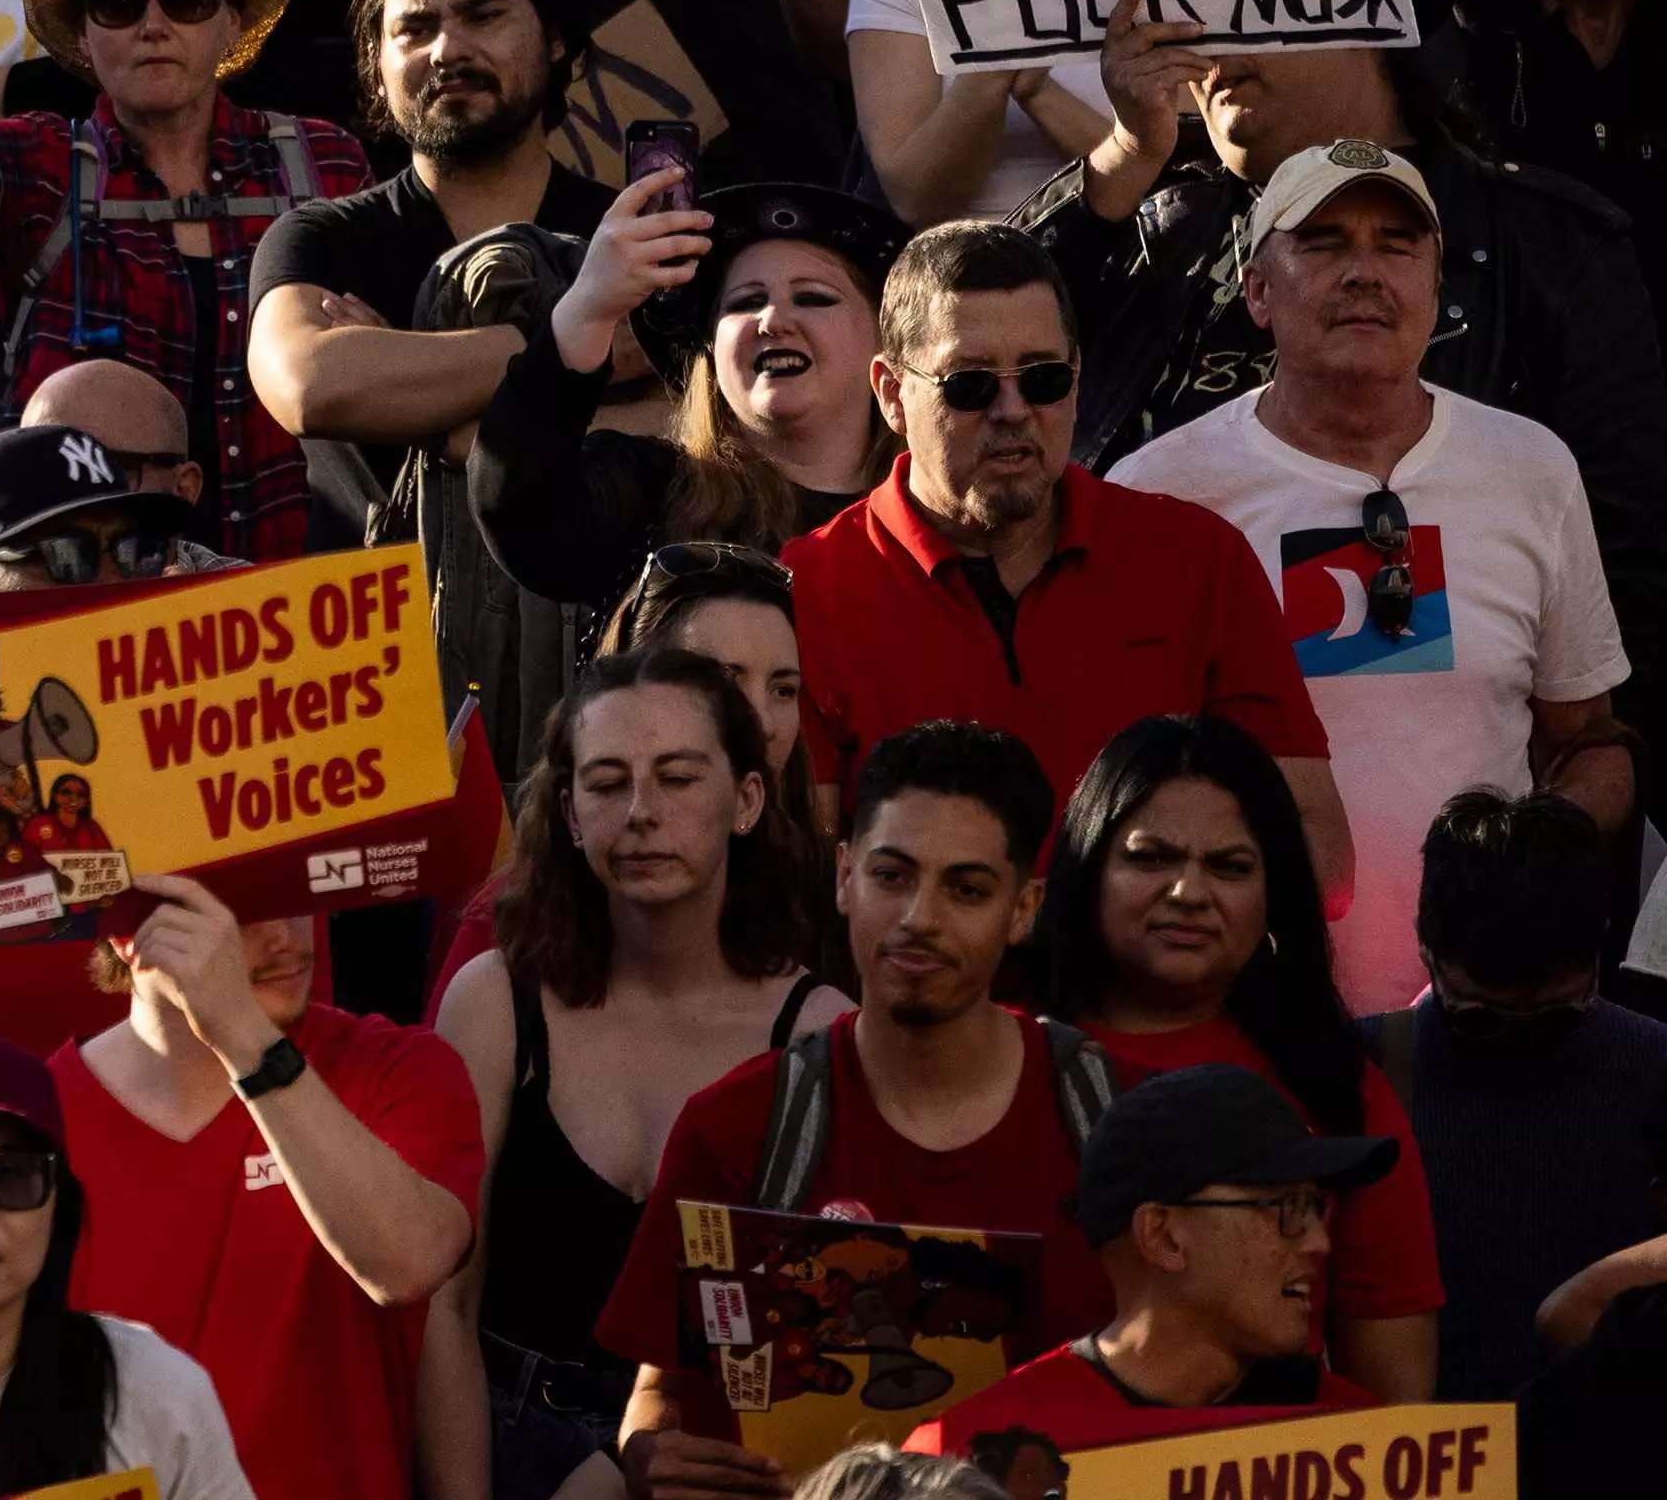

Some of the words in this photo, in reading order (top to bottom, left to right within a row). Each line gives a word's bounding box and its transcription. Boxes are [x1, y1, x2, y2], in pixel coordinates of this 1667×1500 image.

[58, 434, 116, 485] NY
[97, 596, 295, 705] HANDS
[308, 562, 411, 650] OFF
[138, 643, 402, 772] Workers'
[196, 746, 386, 842] Voices
[365, 837, 429, 860] National
[367, 855, 419, 873] Nurses
[369, 868, 419, 886] United
[1167, 1442, 1367, 1500] HANDS
[1383, 1424, 1490, 1500] OFF
